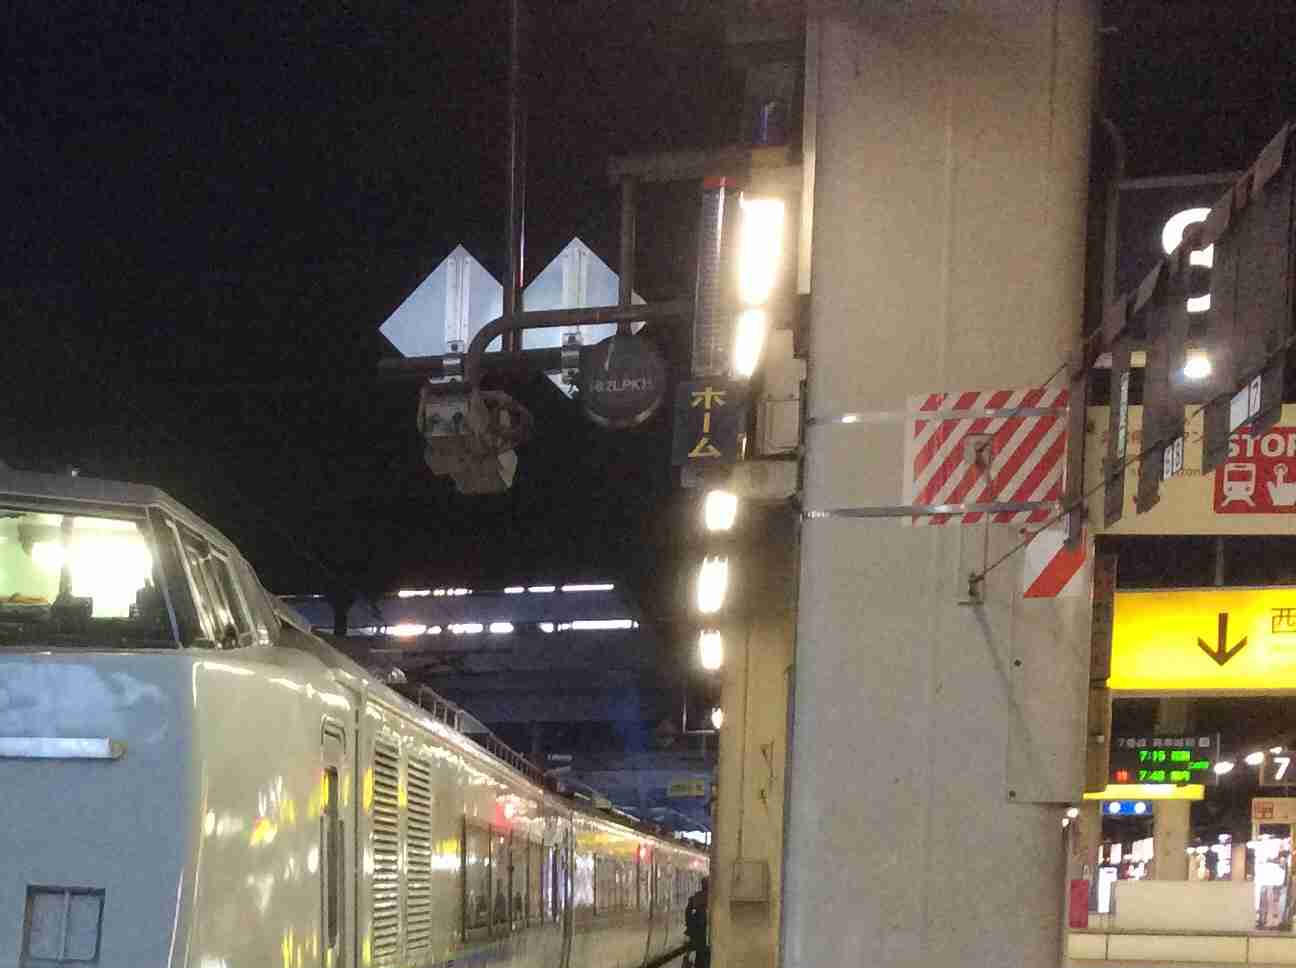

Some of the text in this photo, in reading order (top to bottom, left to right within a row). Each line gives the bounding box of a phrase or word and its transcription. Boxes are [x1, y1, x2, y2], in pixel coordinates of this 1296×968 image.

[688, 386, 727, 458] ホーム
[1274, 757, 1291, 781] 7
